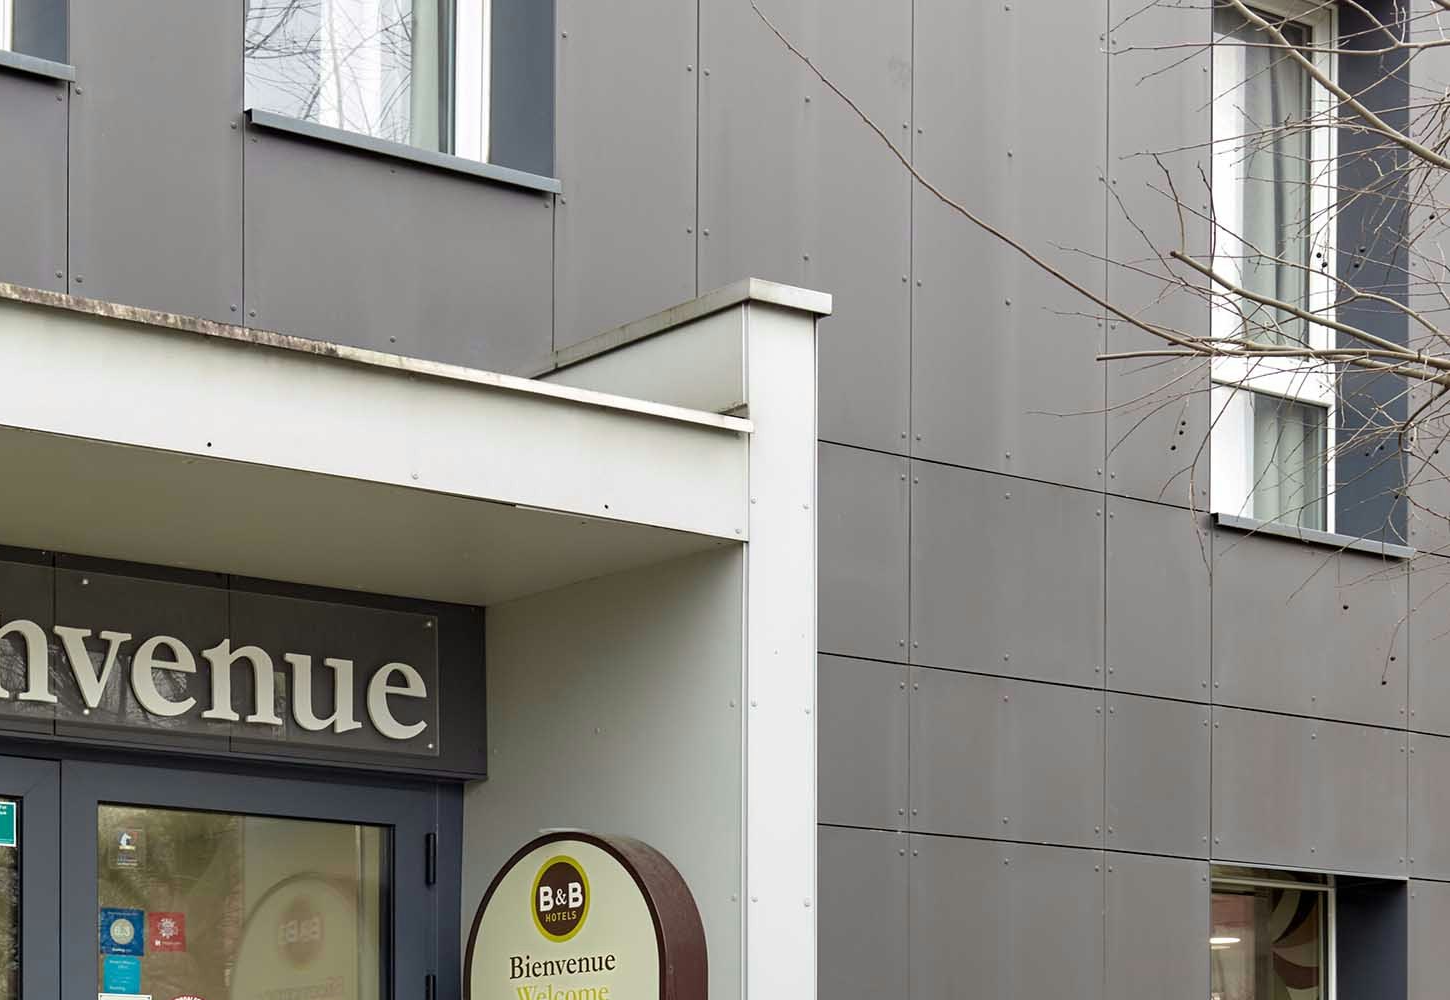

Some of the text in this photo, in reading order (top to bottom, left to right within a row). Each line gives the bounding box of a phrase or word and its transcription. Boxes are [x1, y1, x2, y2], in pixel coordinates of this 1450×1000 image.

[539, 881, 584, 912] B&B
[545, 910, 578, 923] HOTELS
[509, 953, 616, 980] Bienvenue
